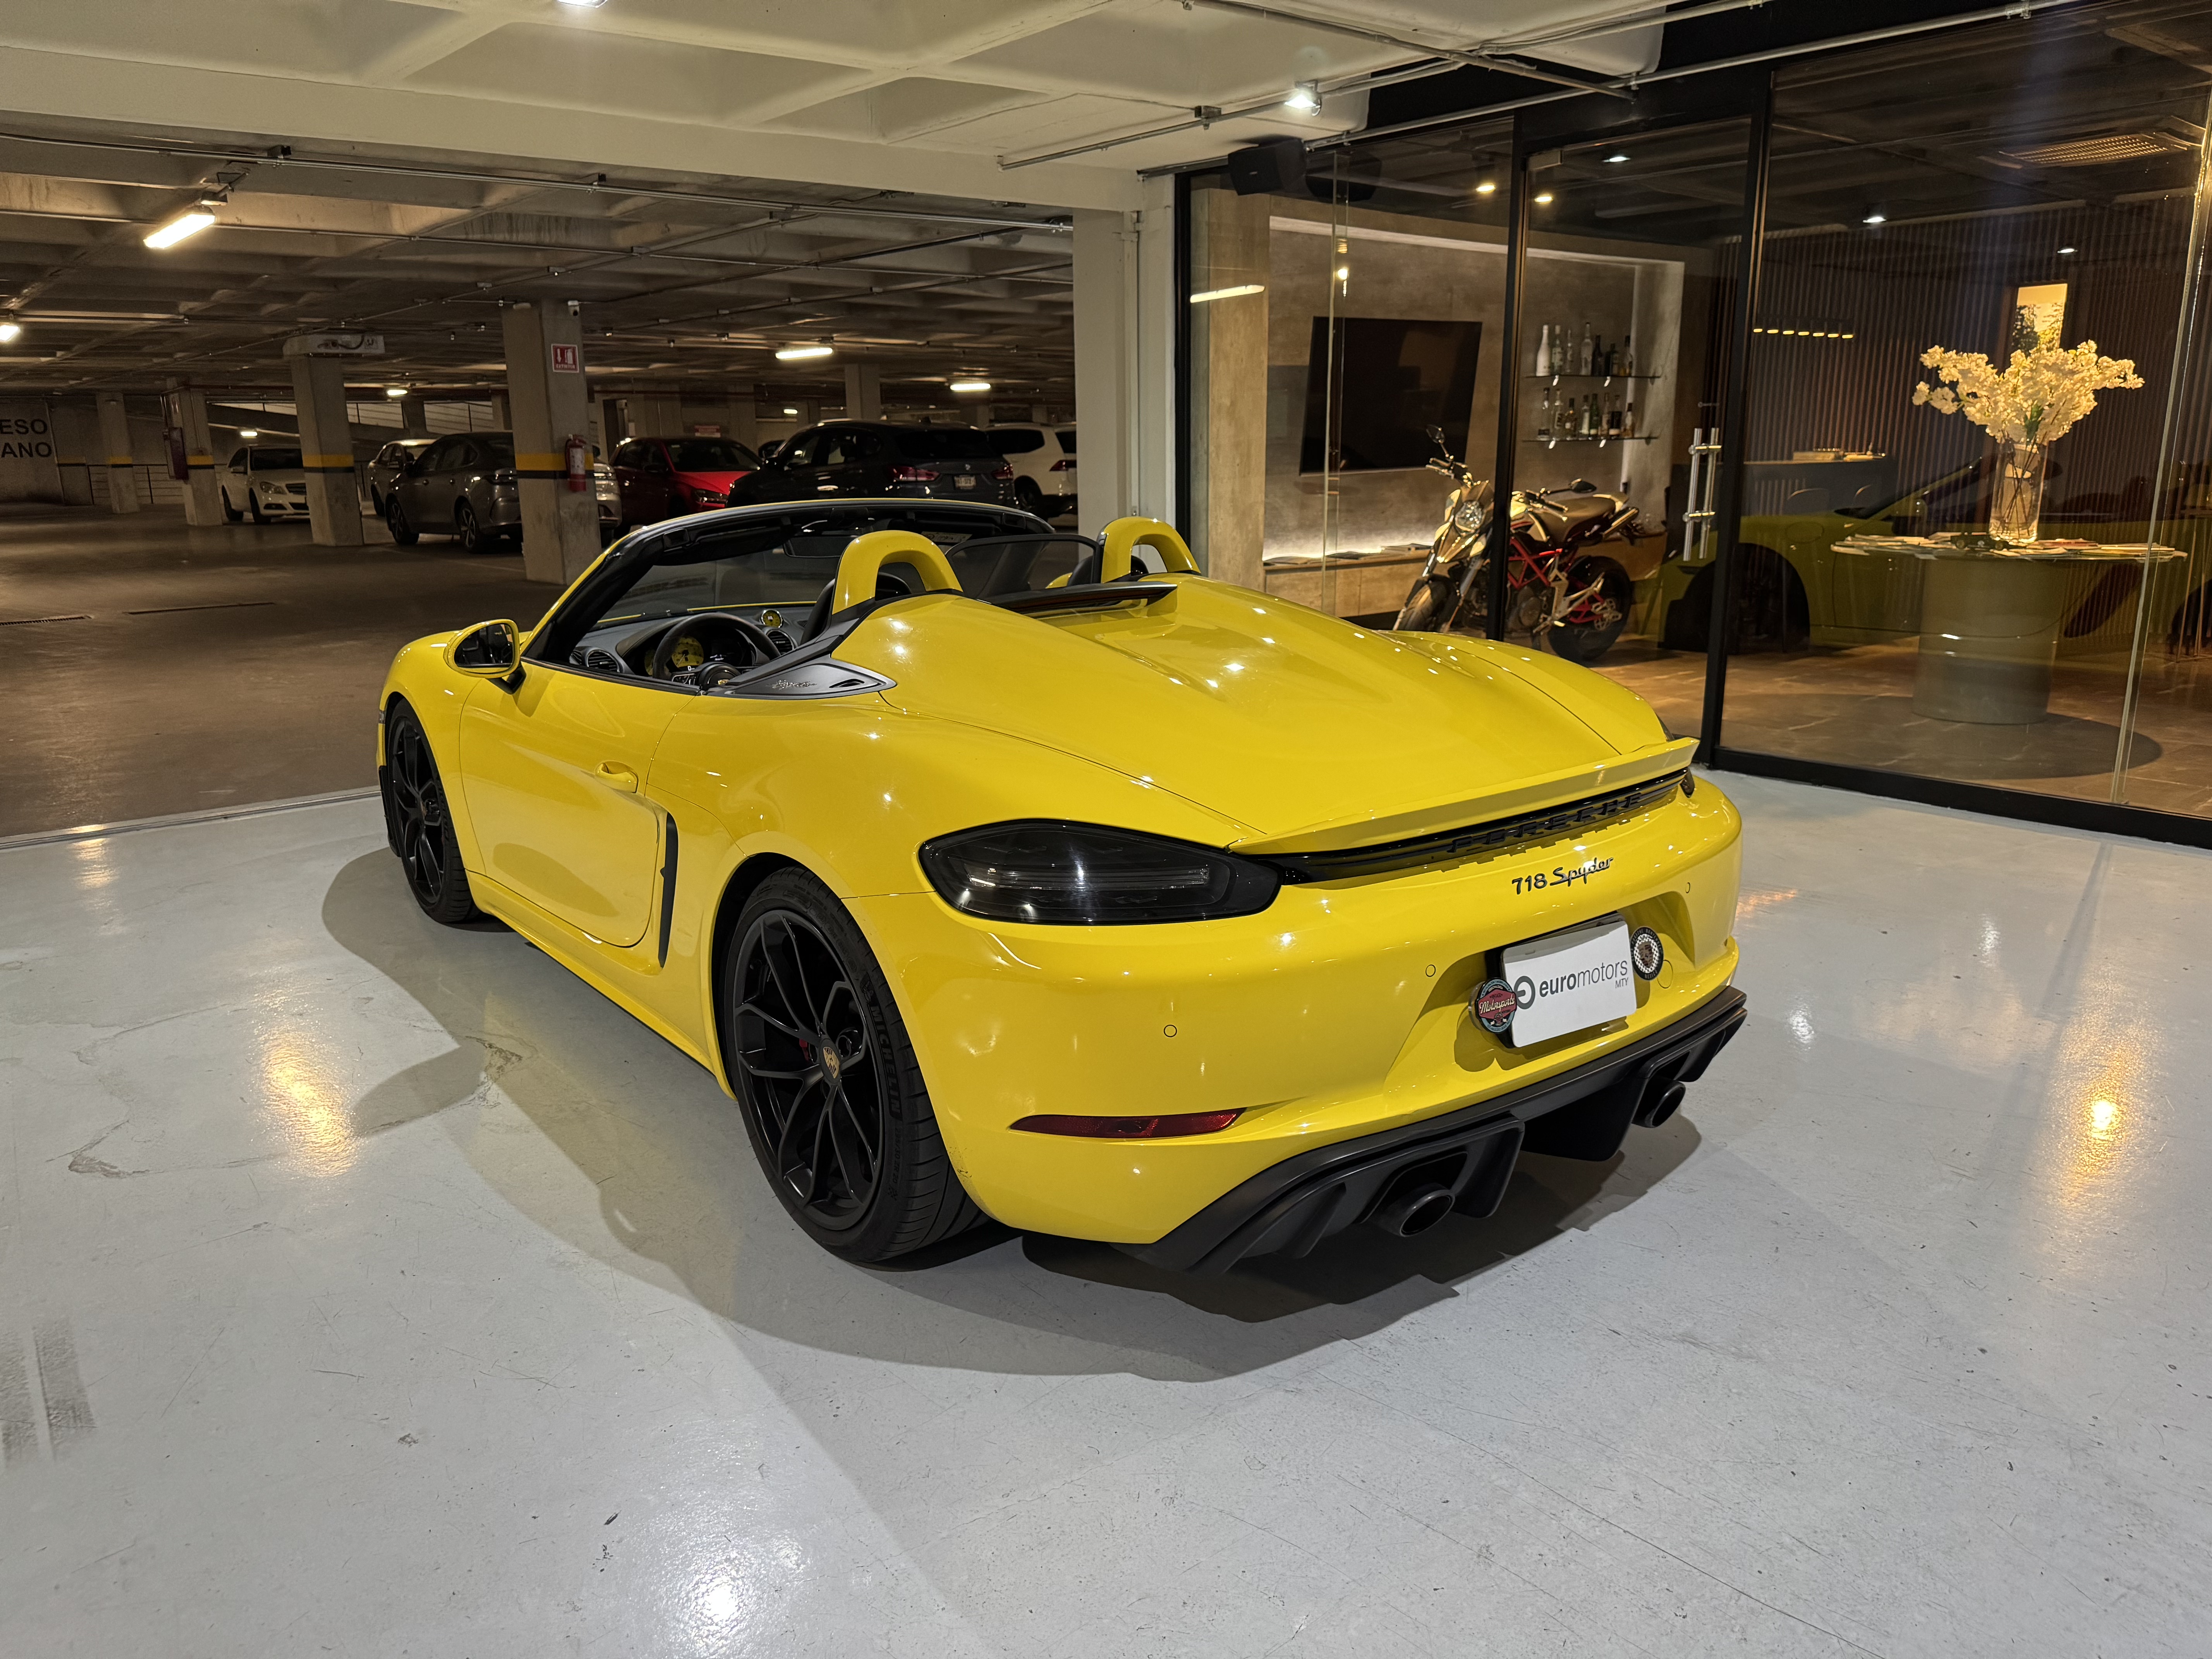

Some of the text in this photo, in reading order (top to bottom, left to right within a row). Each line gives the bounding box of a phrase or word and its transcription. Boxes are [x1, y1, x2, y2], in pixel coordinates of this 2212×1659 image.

[1, 442, 52, 458] ANO
[1511, 857, 1614, 895] 718 Spyder
[1539, 960, 1627, 998] euromotors
[1615, 977, 1628, 989] MTY
[1479, 994, 1515, 1014] Motorsports
[871, 1005, 901, 1114] MICHELIN
